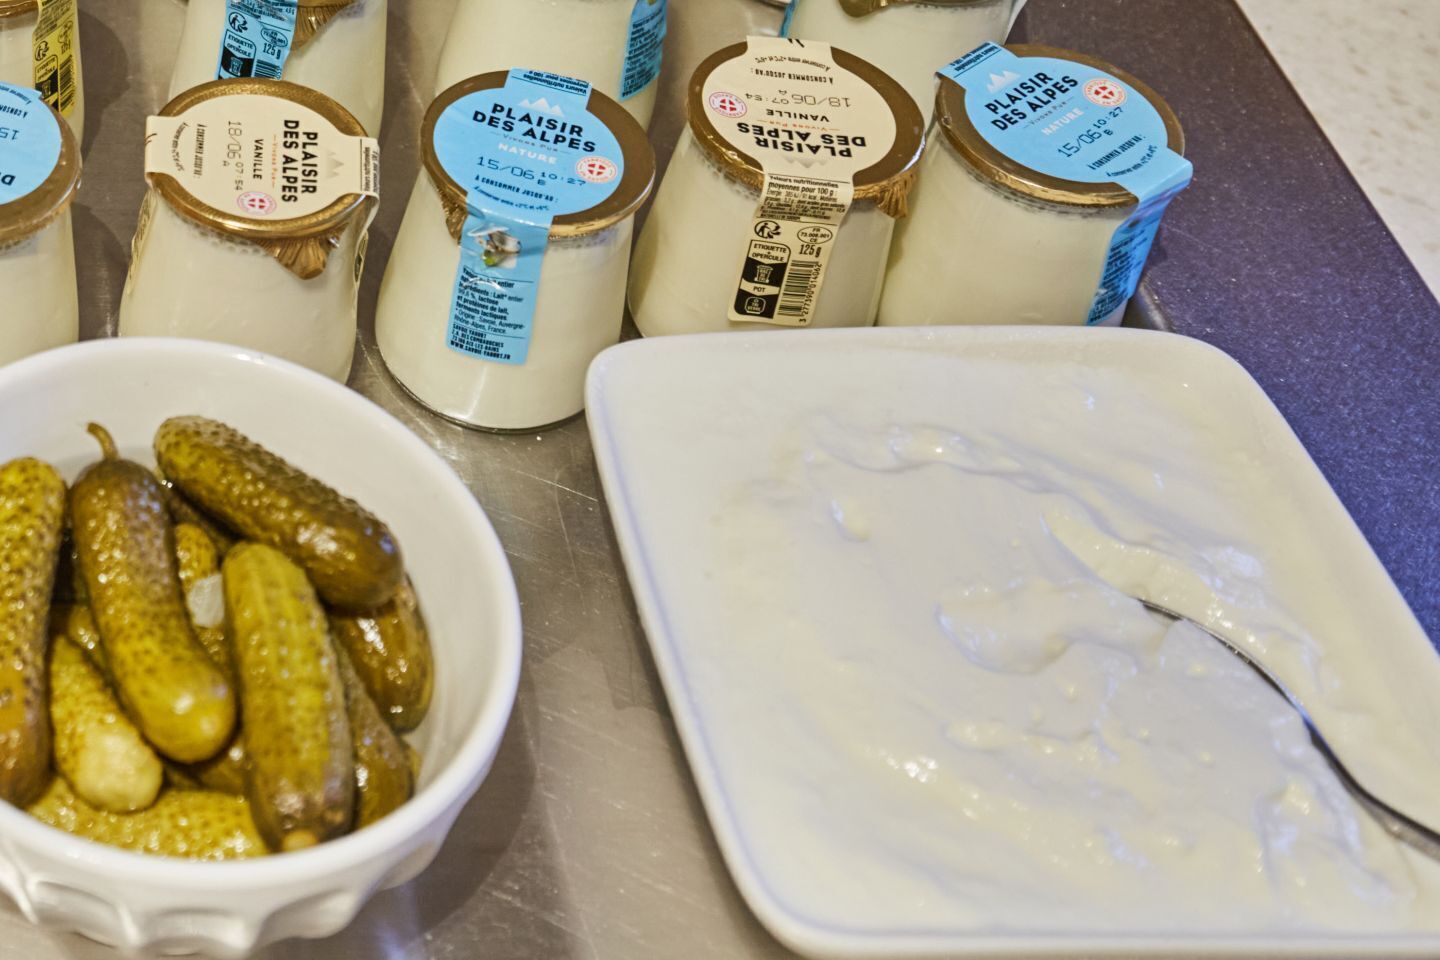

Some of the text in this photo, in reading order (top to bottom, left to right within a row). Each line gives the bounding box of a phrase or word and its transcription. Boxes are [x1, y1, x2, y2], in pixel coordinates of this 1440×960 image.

[788, 73, 827, 83] CONSOMMER
[791, 94, 851, 108] 18/06
[984, 72, 1054, 115] PLAISIR
[991, 76, 1078, 131] DES ALPES
[491, 103, 583, 137] PLAISIR
[766, 109, 829, 122] VANILLE
[1041, 108, 1084, 135] NATURE
[195, 128, 205, 154] CONSOMMER
[227, 120, 242, 159] 18/06
[472, 110, 596, 152] DES ALPES
[737, 122, 866, 147] DES ALPES
[1057, 106, 1123, 158] 15/06 10:27
[253, 139, 264, 180] VANILLE
[498, 143, 557, 164] NATURE
[754, 136, 852, 158] PLAISIR
[281, 120, 299, 202] DES ALPES
[301, 132, 318, 194] PLAISIR
[477, 156, 586, 186] 15/06 10:27
[481, 177, 520, 193] CONSOMMER
[768, 182, 800, 192] moyennes
[752, 252, 784, 262] OPERCULE
[753, 243, 788, 253] ETIQUETTE
[799, 243, 822, 258] 125 g
